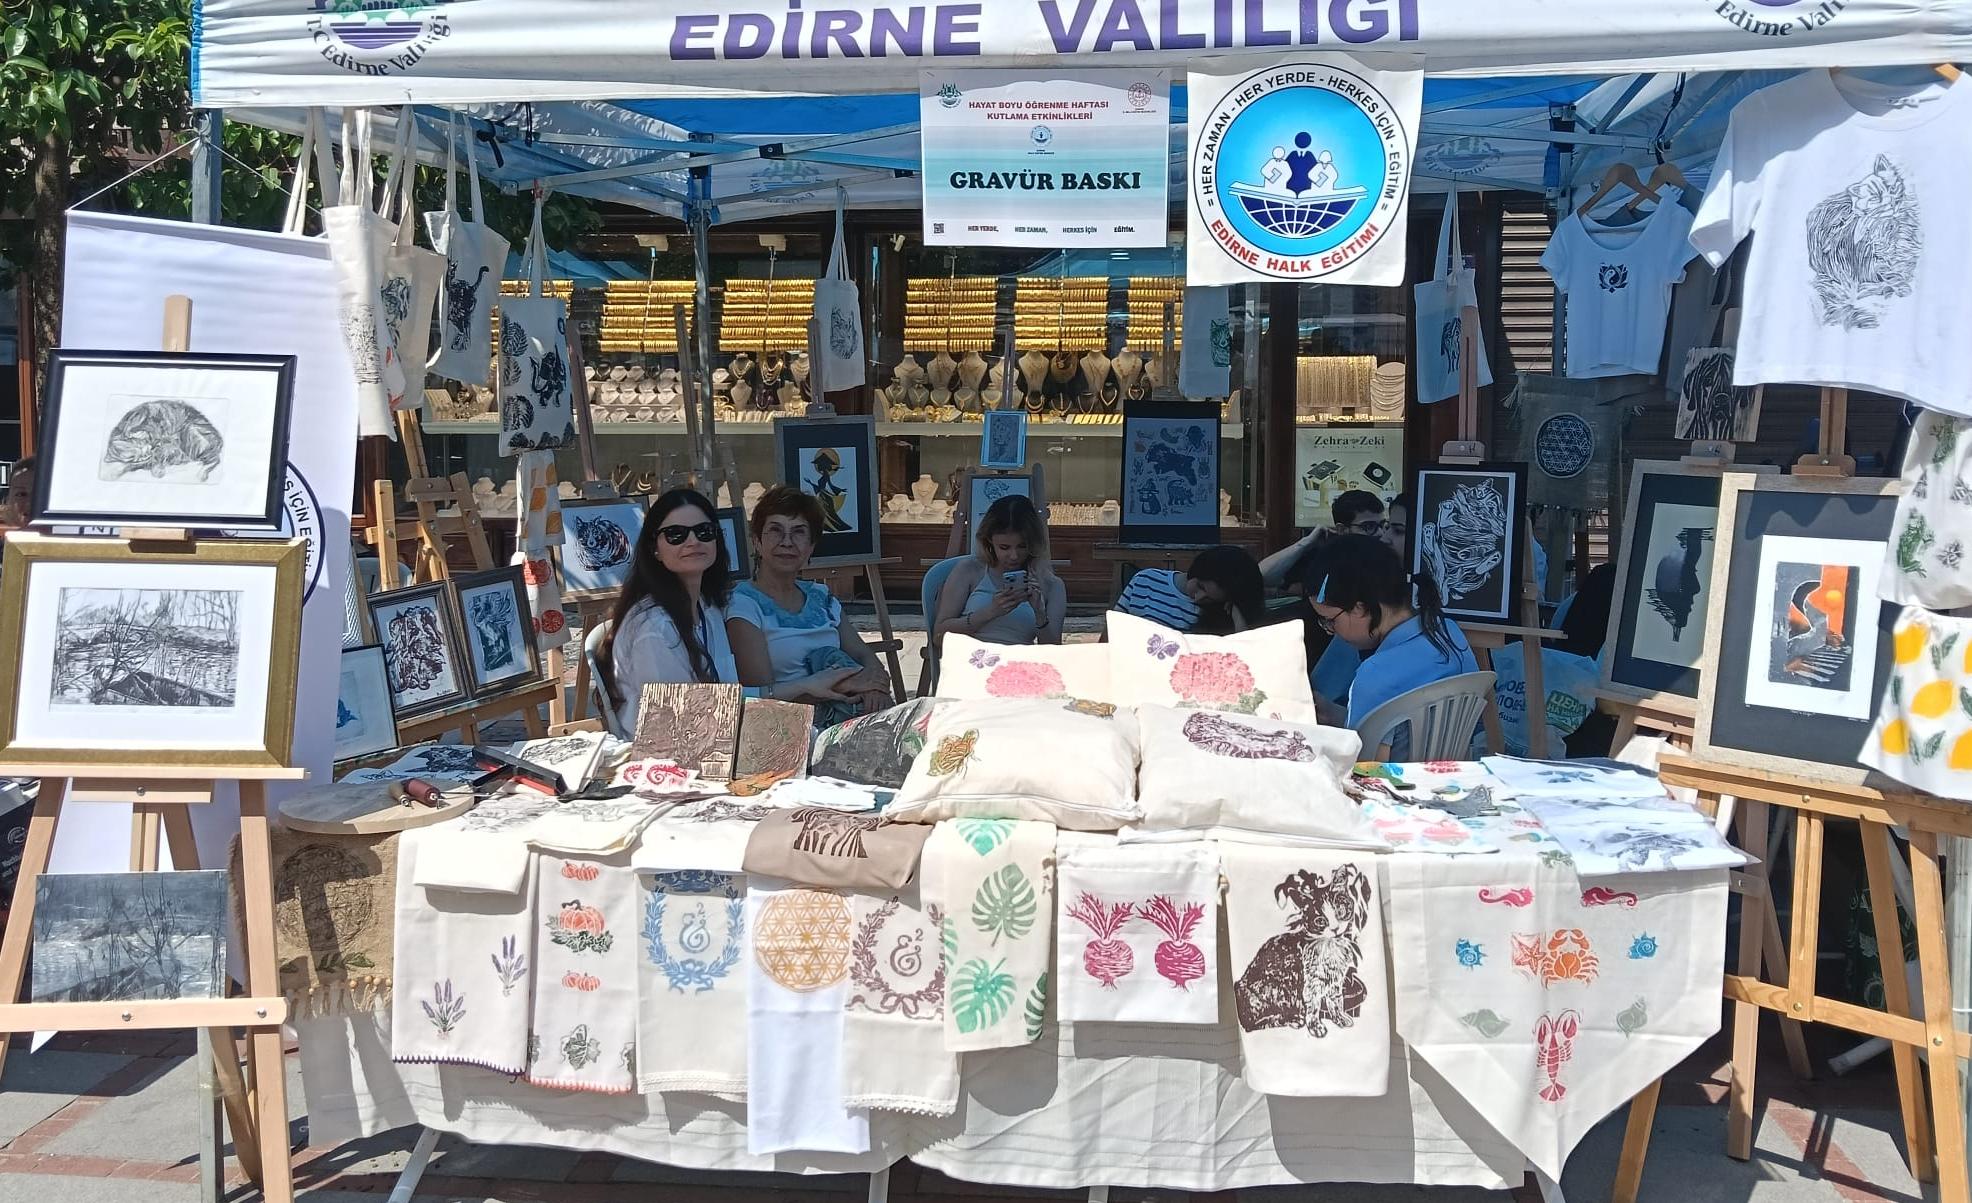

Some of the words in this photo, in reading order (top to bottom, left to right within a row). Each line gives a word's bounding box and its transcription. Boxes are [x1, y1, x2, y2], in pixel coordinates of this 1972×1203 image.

[669, 0, 982, 61] EDİRNE
[1715, 0, 1793, 36] Edirne
[320, 44, 391, 76] Edirne
[1235, 83, 1265, 107] HER
[1265, 71, 1316, 89] YERDE
[1327, 75, 1380, 115] HERKES
[969, 101, 997, 109] HAYAT
[999, 101, 1023, 109] BOYU
[1025, 100, 1069, 109] ÖĞRENME
[1071, 101, 1109, 109] HAFTASI
[986, 112, 1029, 120] KUTLAMA
[1031, 111, 1093, 120] ETKİNLİKLERİ
[1203, 111, 1232, 162] ZAMAN
[1375, 111, 1397, 141] İÇİN
[949, 168, 1055, 190] GRAVÜR
[1061, 171, 1141, 190] BASKI
[1202, 165, 1214, 196] HER
[1384, 151, 1403, 200] EĞİTİM
[1210, 218, 1260, 266] EDİRNE
[1266, 258, 1312, 273] HALK
[1321, 222, 1379, 270] EĞİTİMİ
[1314, 435, 1349, 445] Zehra
[1360, 435, 1385, 445] Zeki
[289, 490, 310, 523] İÇİN
